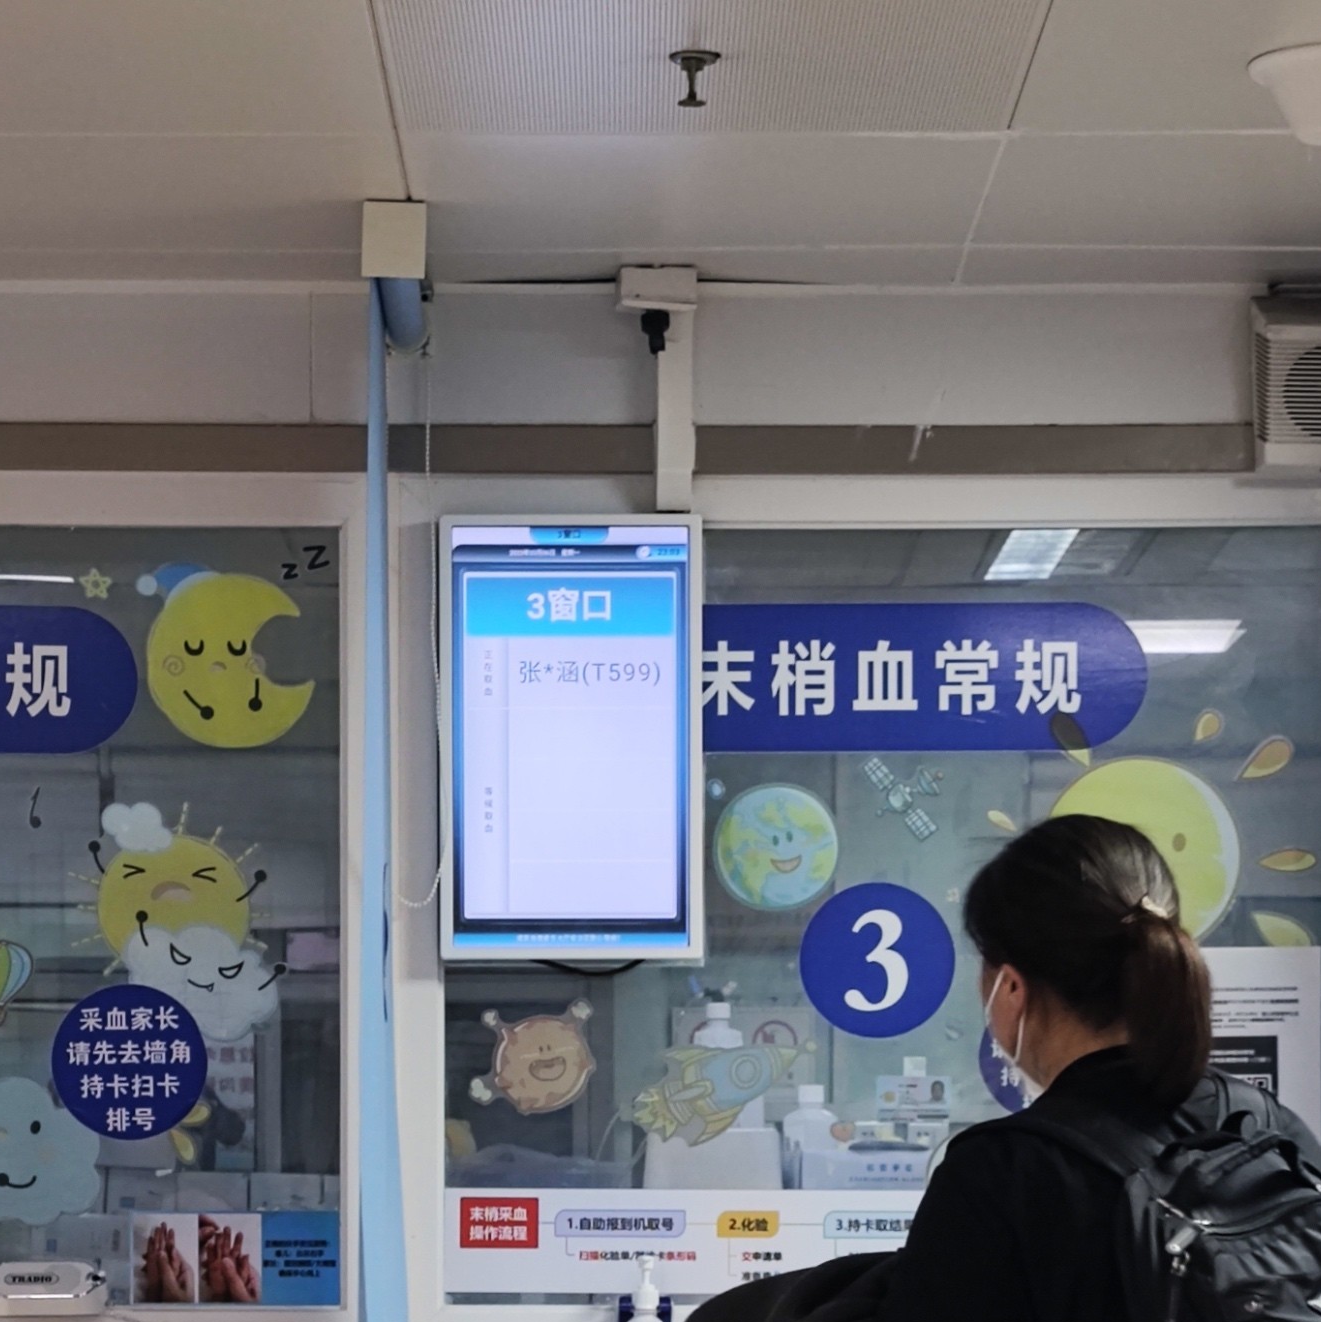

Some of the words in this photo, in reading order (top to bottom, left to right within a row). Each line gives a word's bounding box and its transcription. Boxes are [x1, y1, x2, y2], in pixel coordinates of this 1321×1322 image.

[526, 588, 613, 622] 3窗口
[702, 638, 1083, 717] 末梢血常规
[843, 907, 910, 1012] 3
[79, 1006, 180, 1032] 采血家长
[66, 1040, 192, 1066] 请先去墙角
[80, 1073, 181, 1100] 持卡扫卡
[106, 1107, 157, 1133] 排号
[469, 1207, 528, 1222] 末梢采血
[566, 1217, 675, 1233] 1.自助报到机取号
[728, 1217, 769, 1233] 2.化验
[469, 1226, 528, 1242] 操作流程
